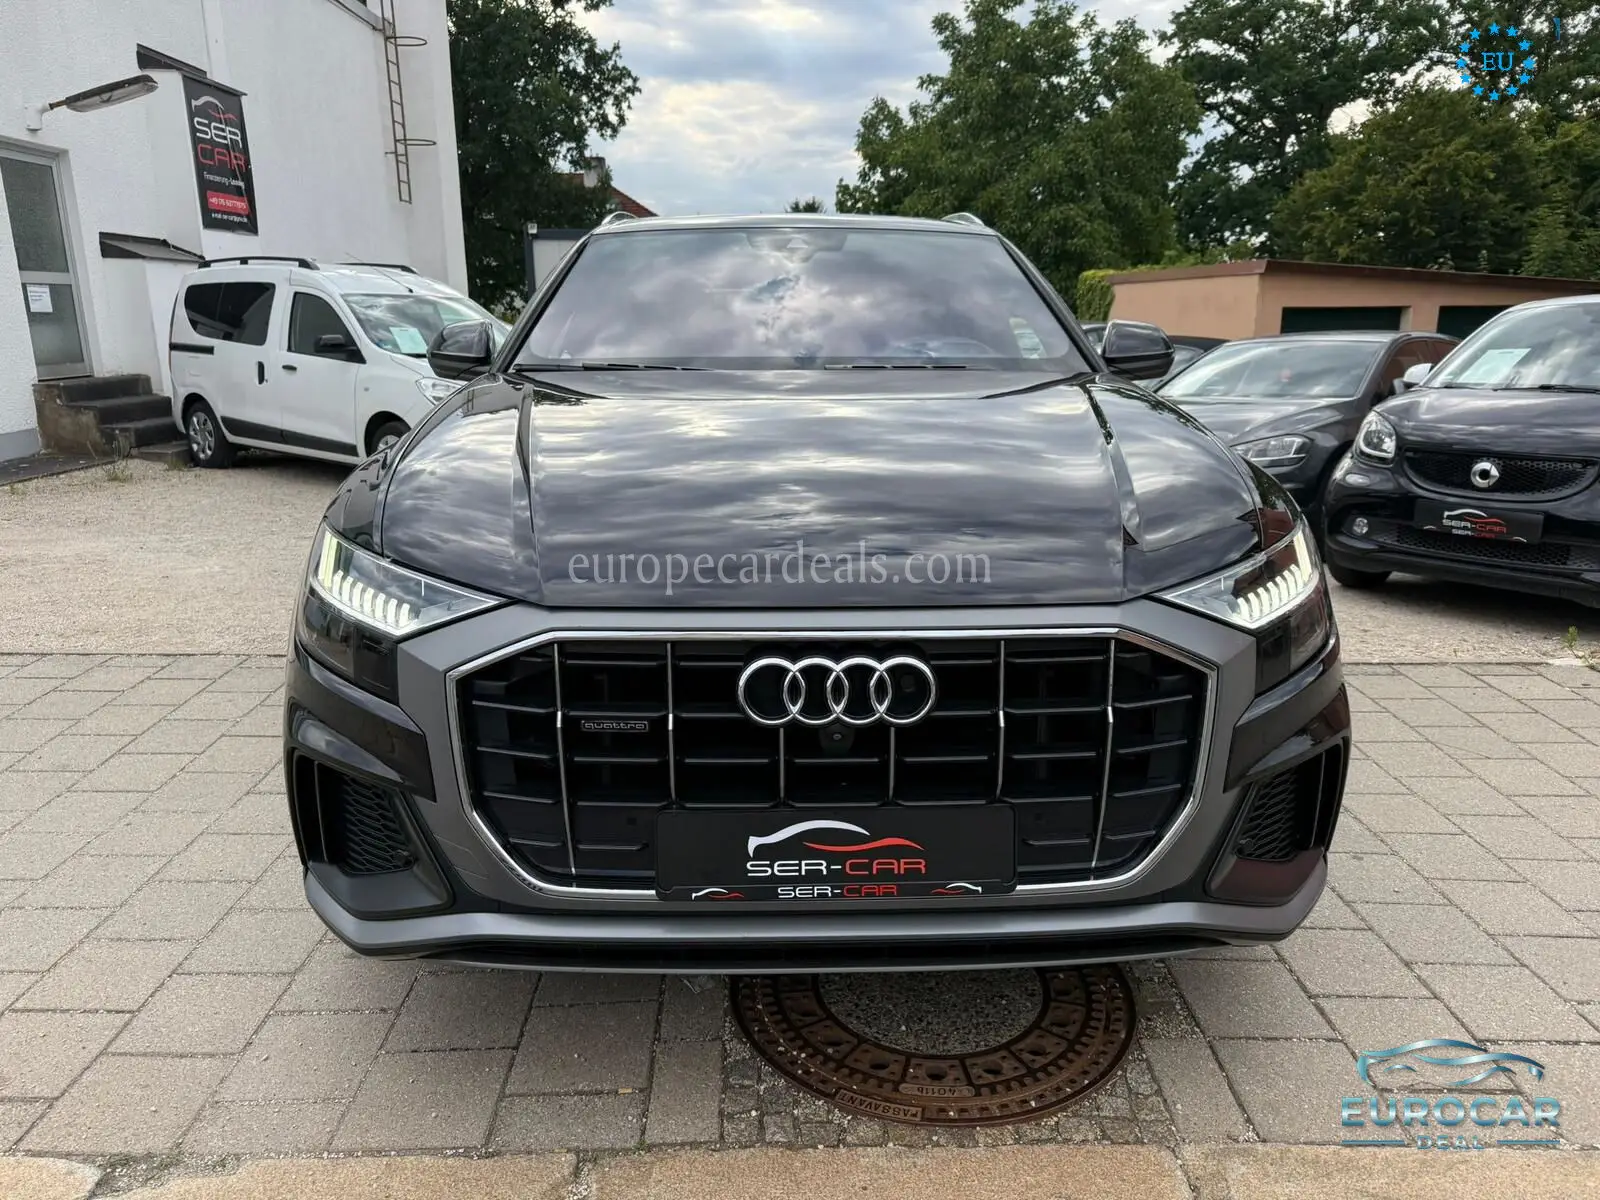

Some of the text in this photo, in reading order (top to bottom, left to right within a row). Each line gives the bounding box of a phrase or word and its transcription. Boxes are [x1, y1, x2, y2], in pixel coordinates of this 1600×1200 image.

[193, 117, 243, 149] SER
[197, 144, 246, 172] CAR
[1442, 519, 1507, 533] SER-CAR
[584, 722, 645, 730] quattro
[746, 858, 926, 877] SER-CAR
[777, 884, 897, 899] SER-CAR
[839, 1092, 919, 1118] PASSAVANT
